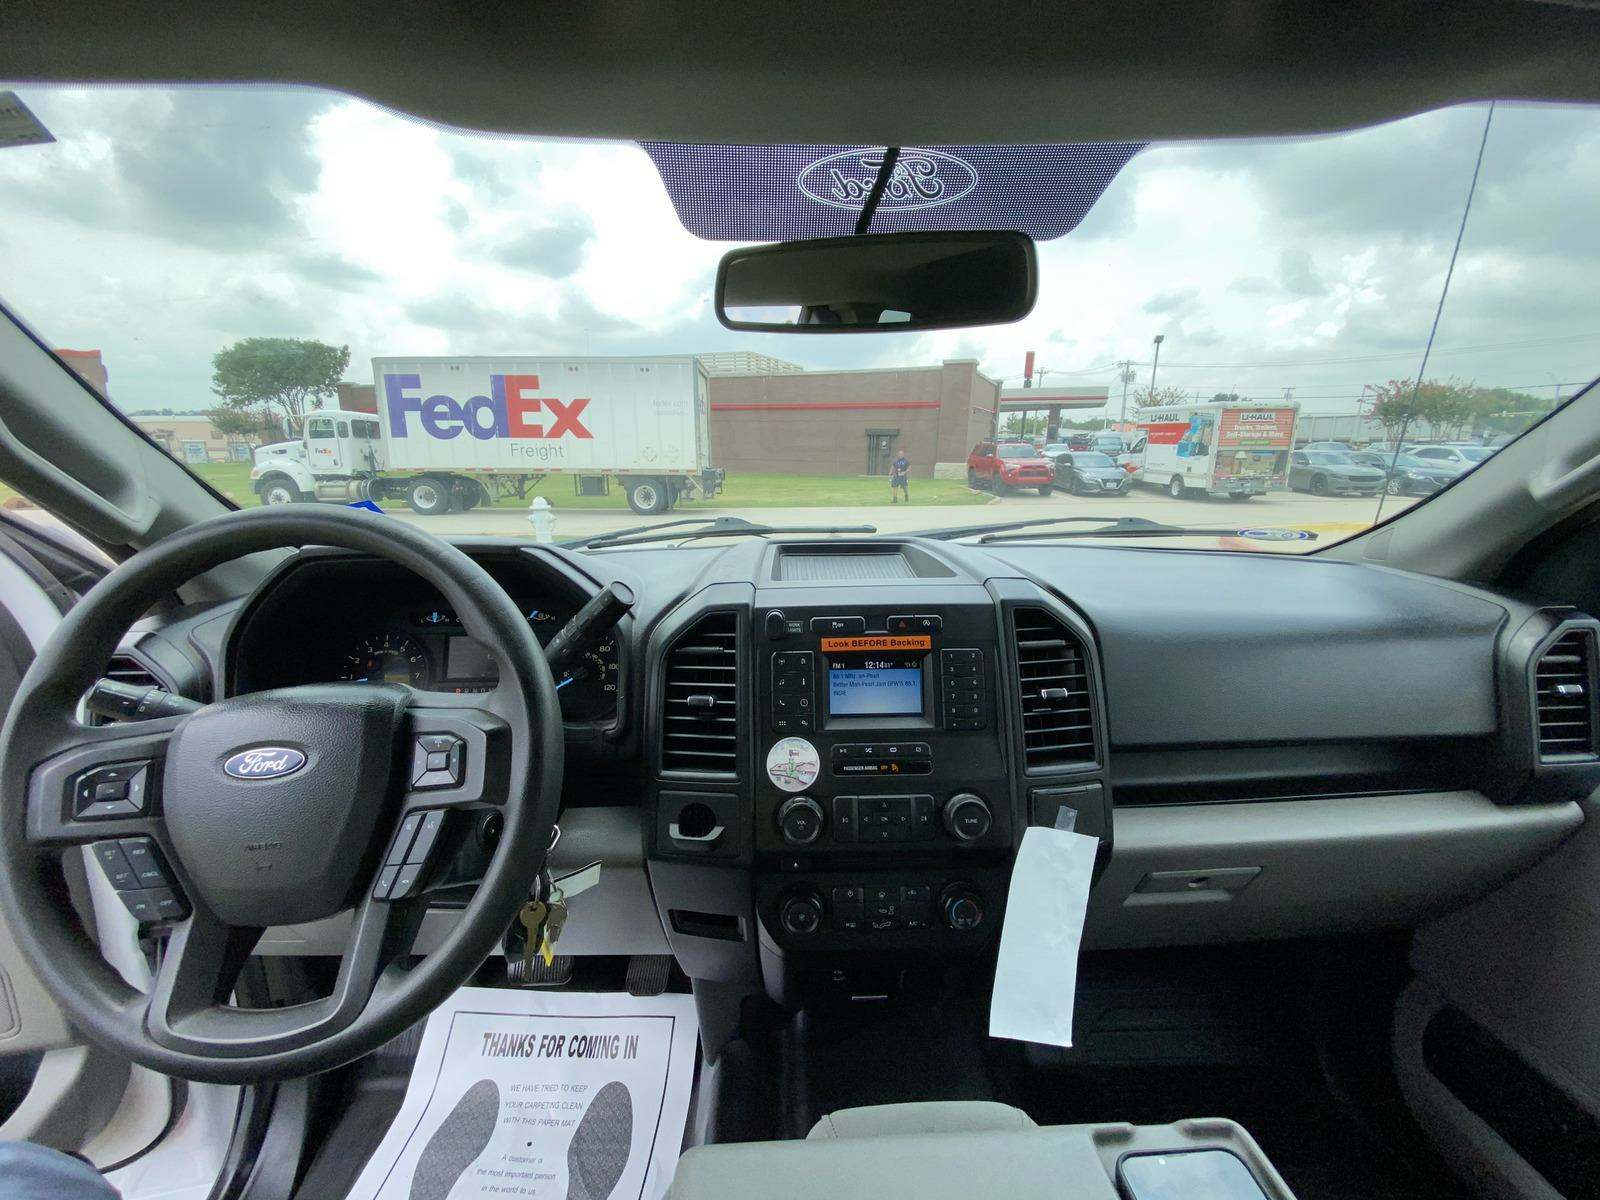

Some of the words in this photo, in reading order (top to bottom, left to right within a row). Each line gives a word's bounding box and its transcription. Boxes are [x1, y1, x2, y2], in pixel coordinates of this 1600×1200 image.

[384, 374, 594, 440] FedEx
[1150, 413, 1180, 422] U-HAUL
[1241, 413, 1274, 421] U-HAUL
[510, 443, 564, 460] Freight
[828, 640, 850, 648] Look
[852, 639, 888, 647] BEFORE
[890, 639, 925, 647] Backing
[864, 661, 884, 669] 12:14
[239, 751, 289, 774] Ford
[481, 1032, 536, 1058] THANKS
[537, 1034, 566, 1058] FOR
[567, 1034, 620, 1059] COMING
[623, 1034, 640, 1060] IN
[510, 1084, 521, 1092] WE
[522, 1084, 540, 1093] HAVE
[541, 1084, 559, 1092] TRIED
[561, 1084, 570, 1092] TO
[571, 1084, 588, 1092] KEEP
[505, 1101, 522, 1109] YOUR
[524, 1101, 560, 1110] CARPETING
[561, 1101, 584, 1110] CLEAN
[503, 1116, 520, 1124] WITH
[521, 1117, 536, 1125] THIS
[538, 1119, 560, 1127] PAPER
[561, 1119, 576, 1127] MAT
[501, 1153, 507, 1161] A
[508, 1155, 536, 1163] customer
[488, 1169, 504, 1178] most
[505, 1170, 534, 1180] important
[534, 1173, 556, 1181] person
[489, 1184, 500, 1193] the
[501, 1185, 519, 1194] world
[520, 1186, 526, 1194] to
